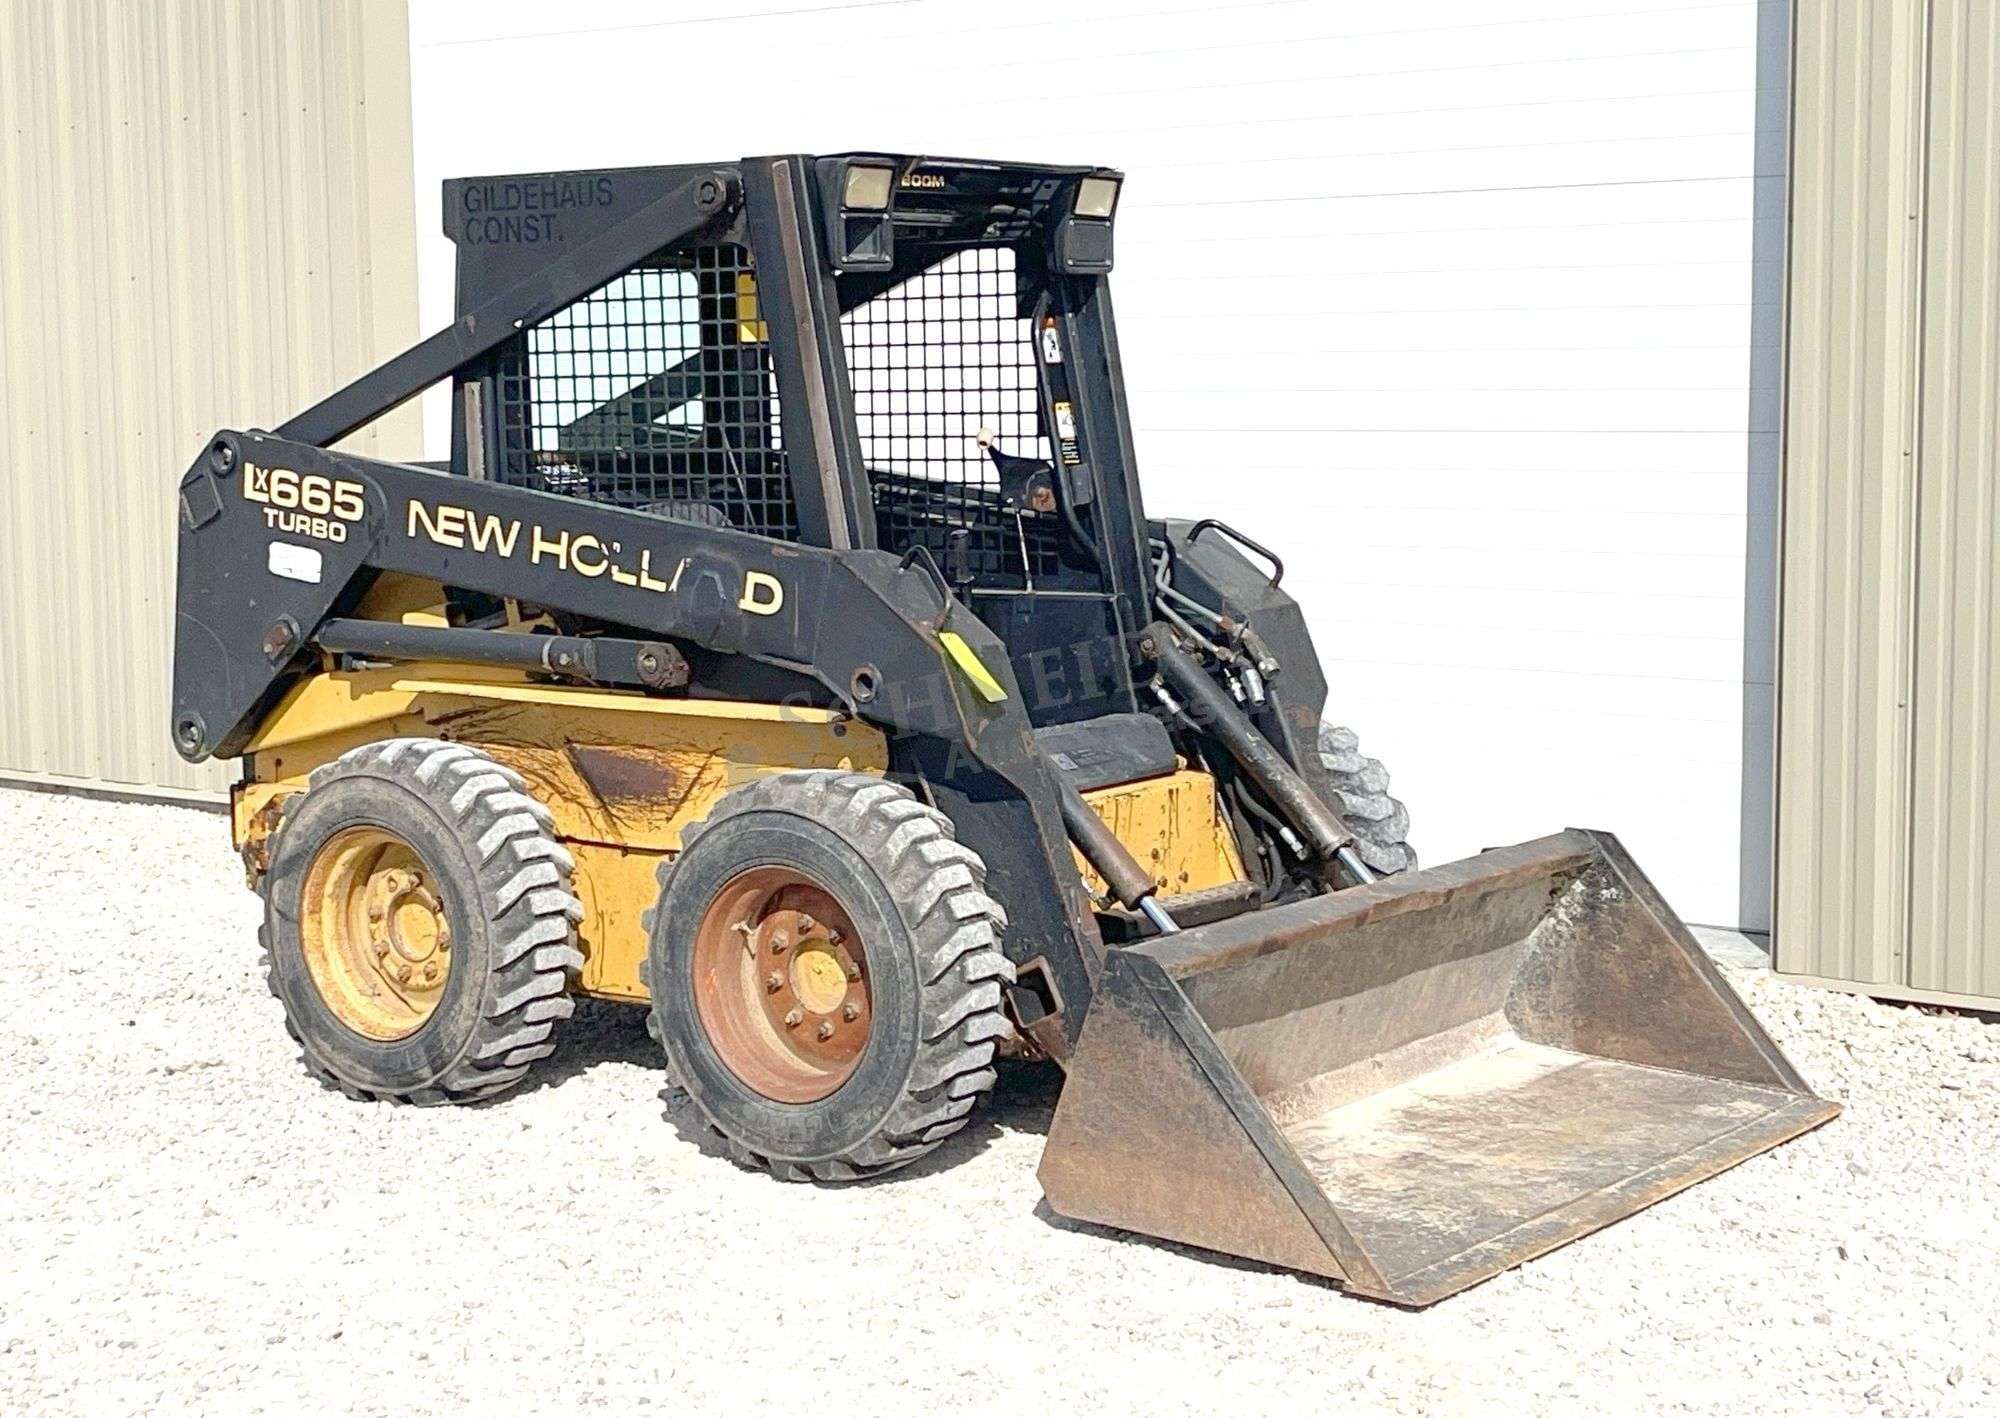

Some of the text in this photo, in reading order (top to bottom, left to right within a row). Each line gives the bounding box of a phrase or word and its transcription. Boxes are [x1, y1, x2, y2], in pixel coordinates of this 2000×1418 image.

[464, 178, 613, 213] GILDEHAUS
[465, 213, 565, 245] CONST.
[262, 506, 347, 543] TURBO
[406, 498, 785, 617] NEW HOLLD
